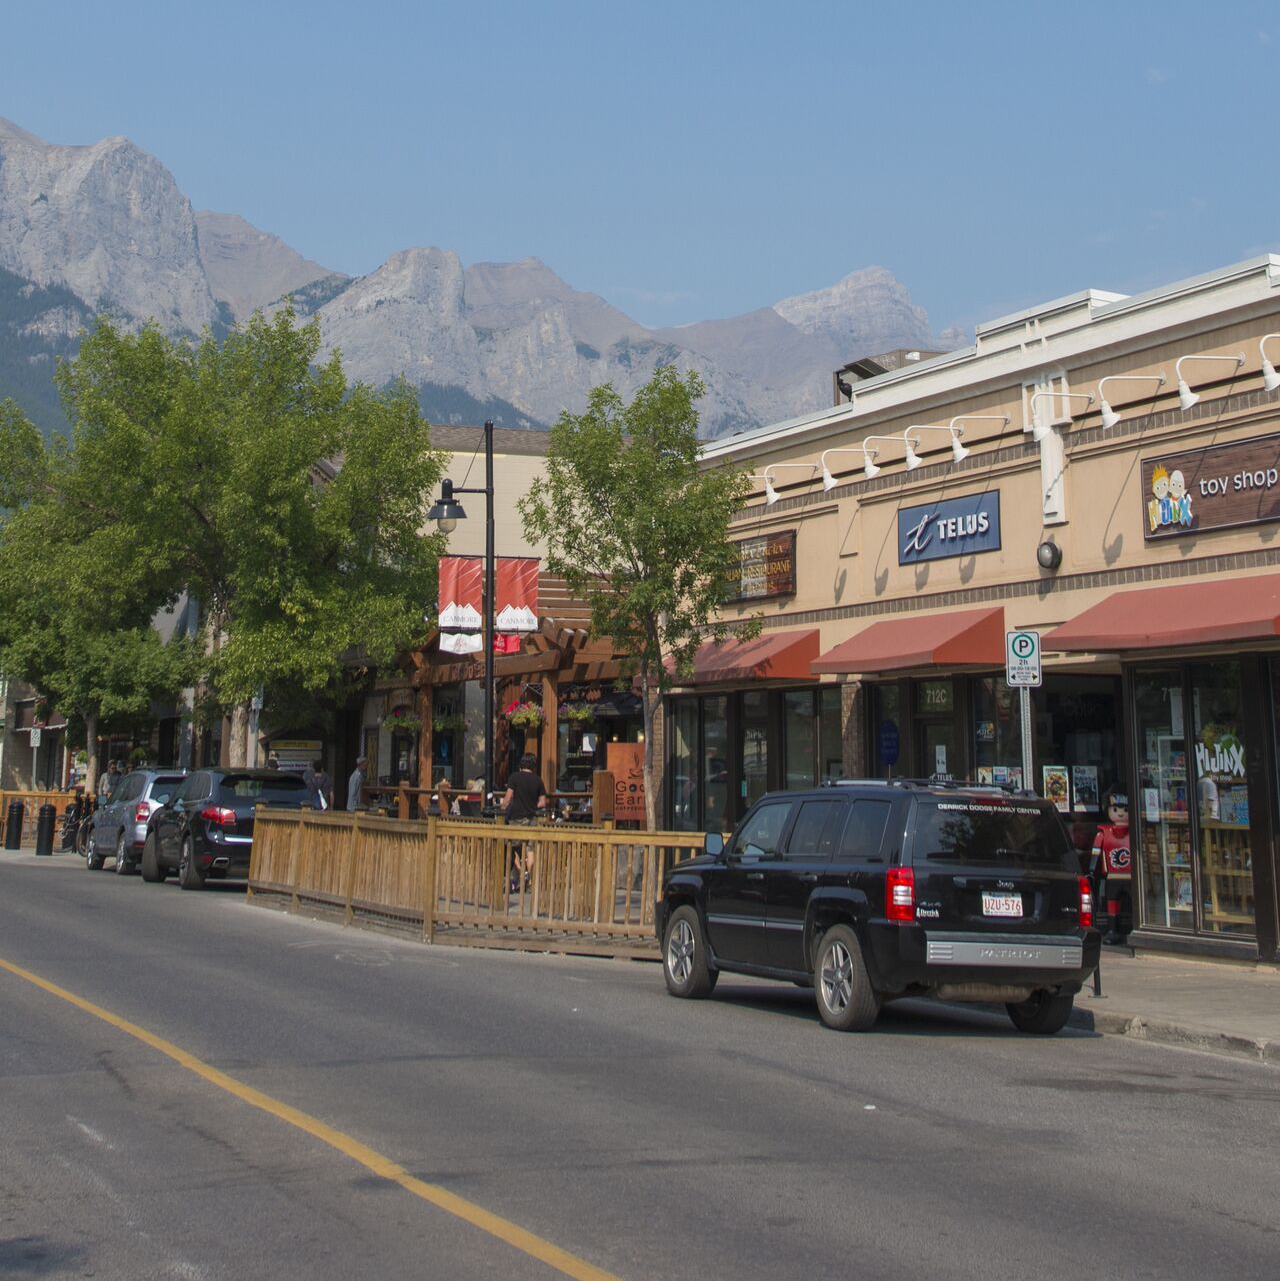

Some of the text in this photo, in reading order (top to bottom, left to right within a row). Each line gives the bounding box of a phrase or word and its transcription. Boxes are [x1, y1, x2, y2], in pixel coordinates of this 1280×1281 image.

[1199, 467, 1279, 496] toy shop
[937, 511, 989, 540] TELUS
[747, 559, 791, 579] RESTAURANT
[443, 615, 477, 623] CANMORE
[500, 615, 535, 624] CANMORE
[1019, 639, 1028, 653] P
[926, 689, 947, 704] 712C
[615, 780, 645, 793] Goo
[615, 793, 646, 805] Ear
[937, 803, 1041, 815] DERRICK DODGE FAMILY CENTER
[996, 879, 1015, 890] Jeep
